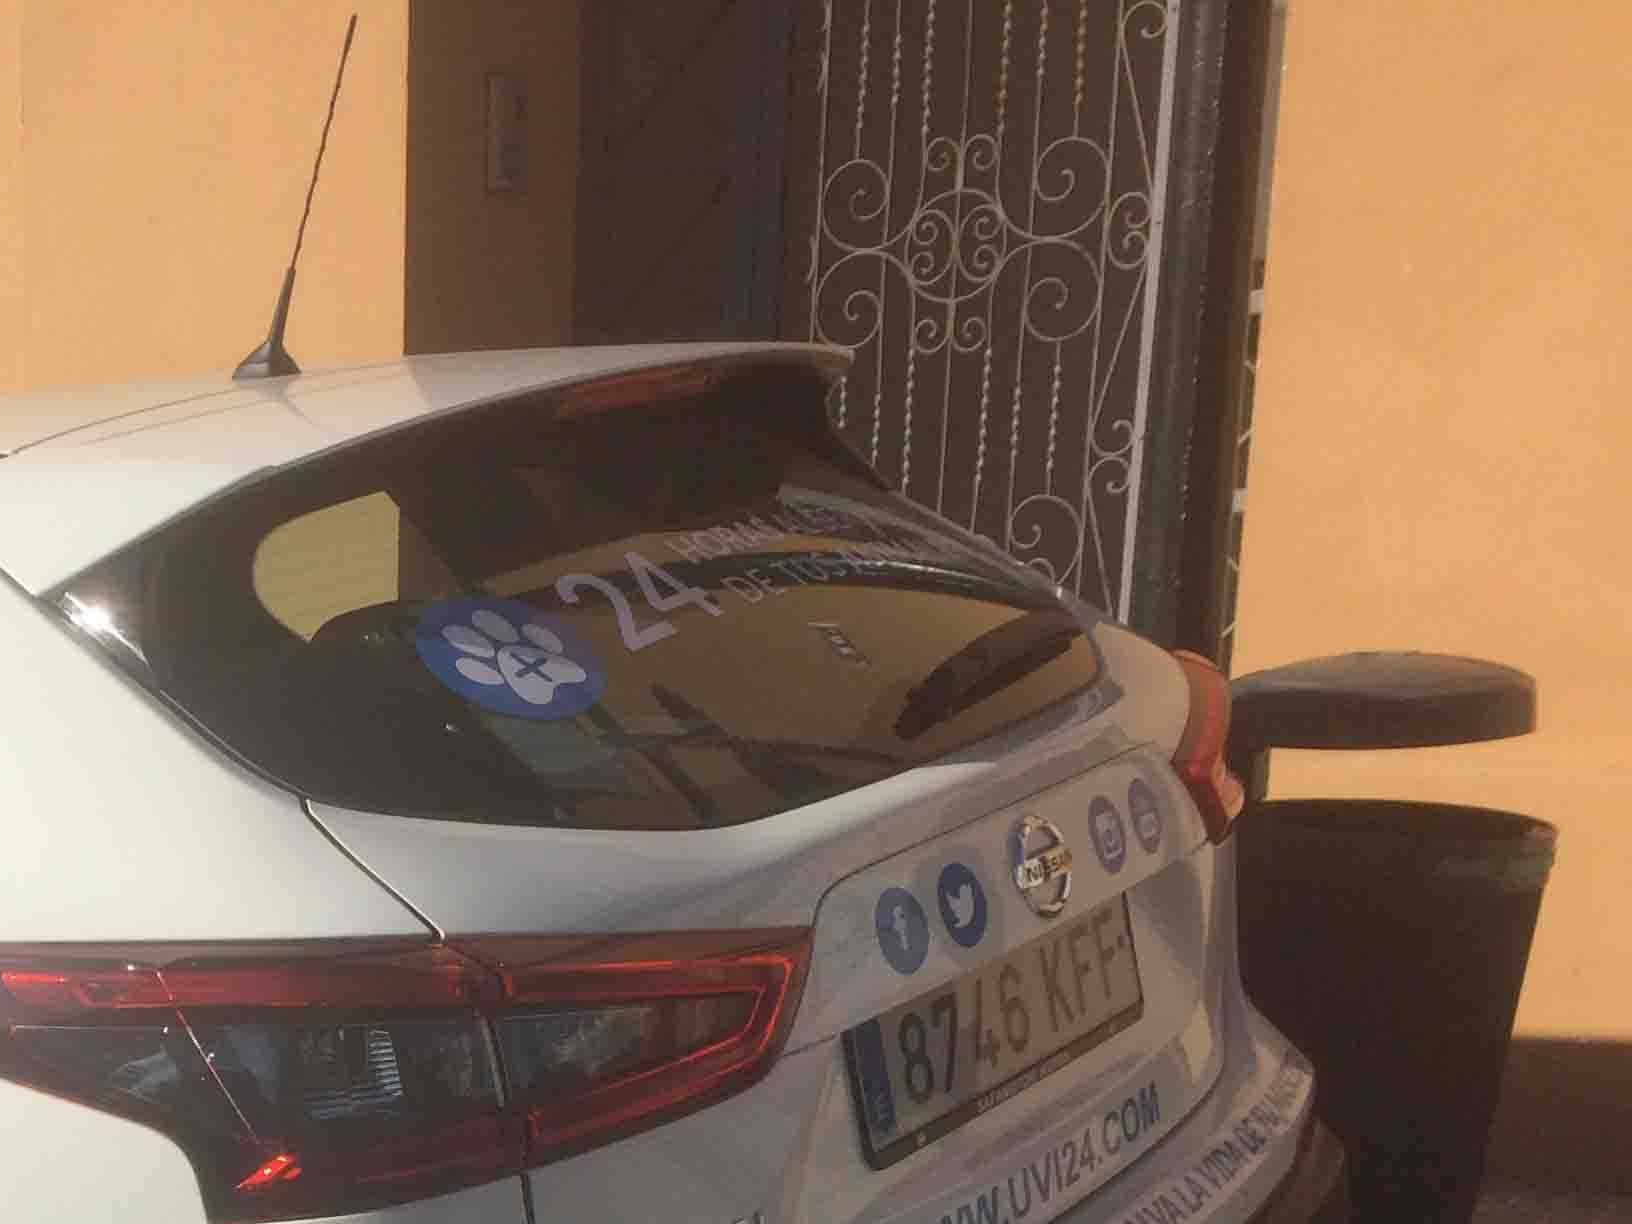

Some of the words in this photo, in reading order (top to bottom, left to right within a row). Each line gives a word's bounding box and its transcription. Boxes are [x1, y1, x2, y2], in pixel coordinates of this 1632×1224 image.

[556, 551, 724, 651] 24
[898, 962, 1030, 1105] 8746
[1039, 905, 1118, 1034] KFF
[1171, 1175, 1213, 1214] LA
